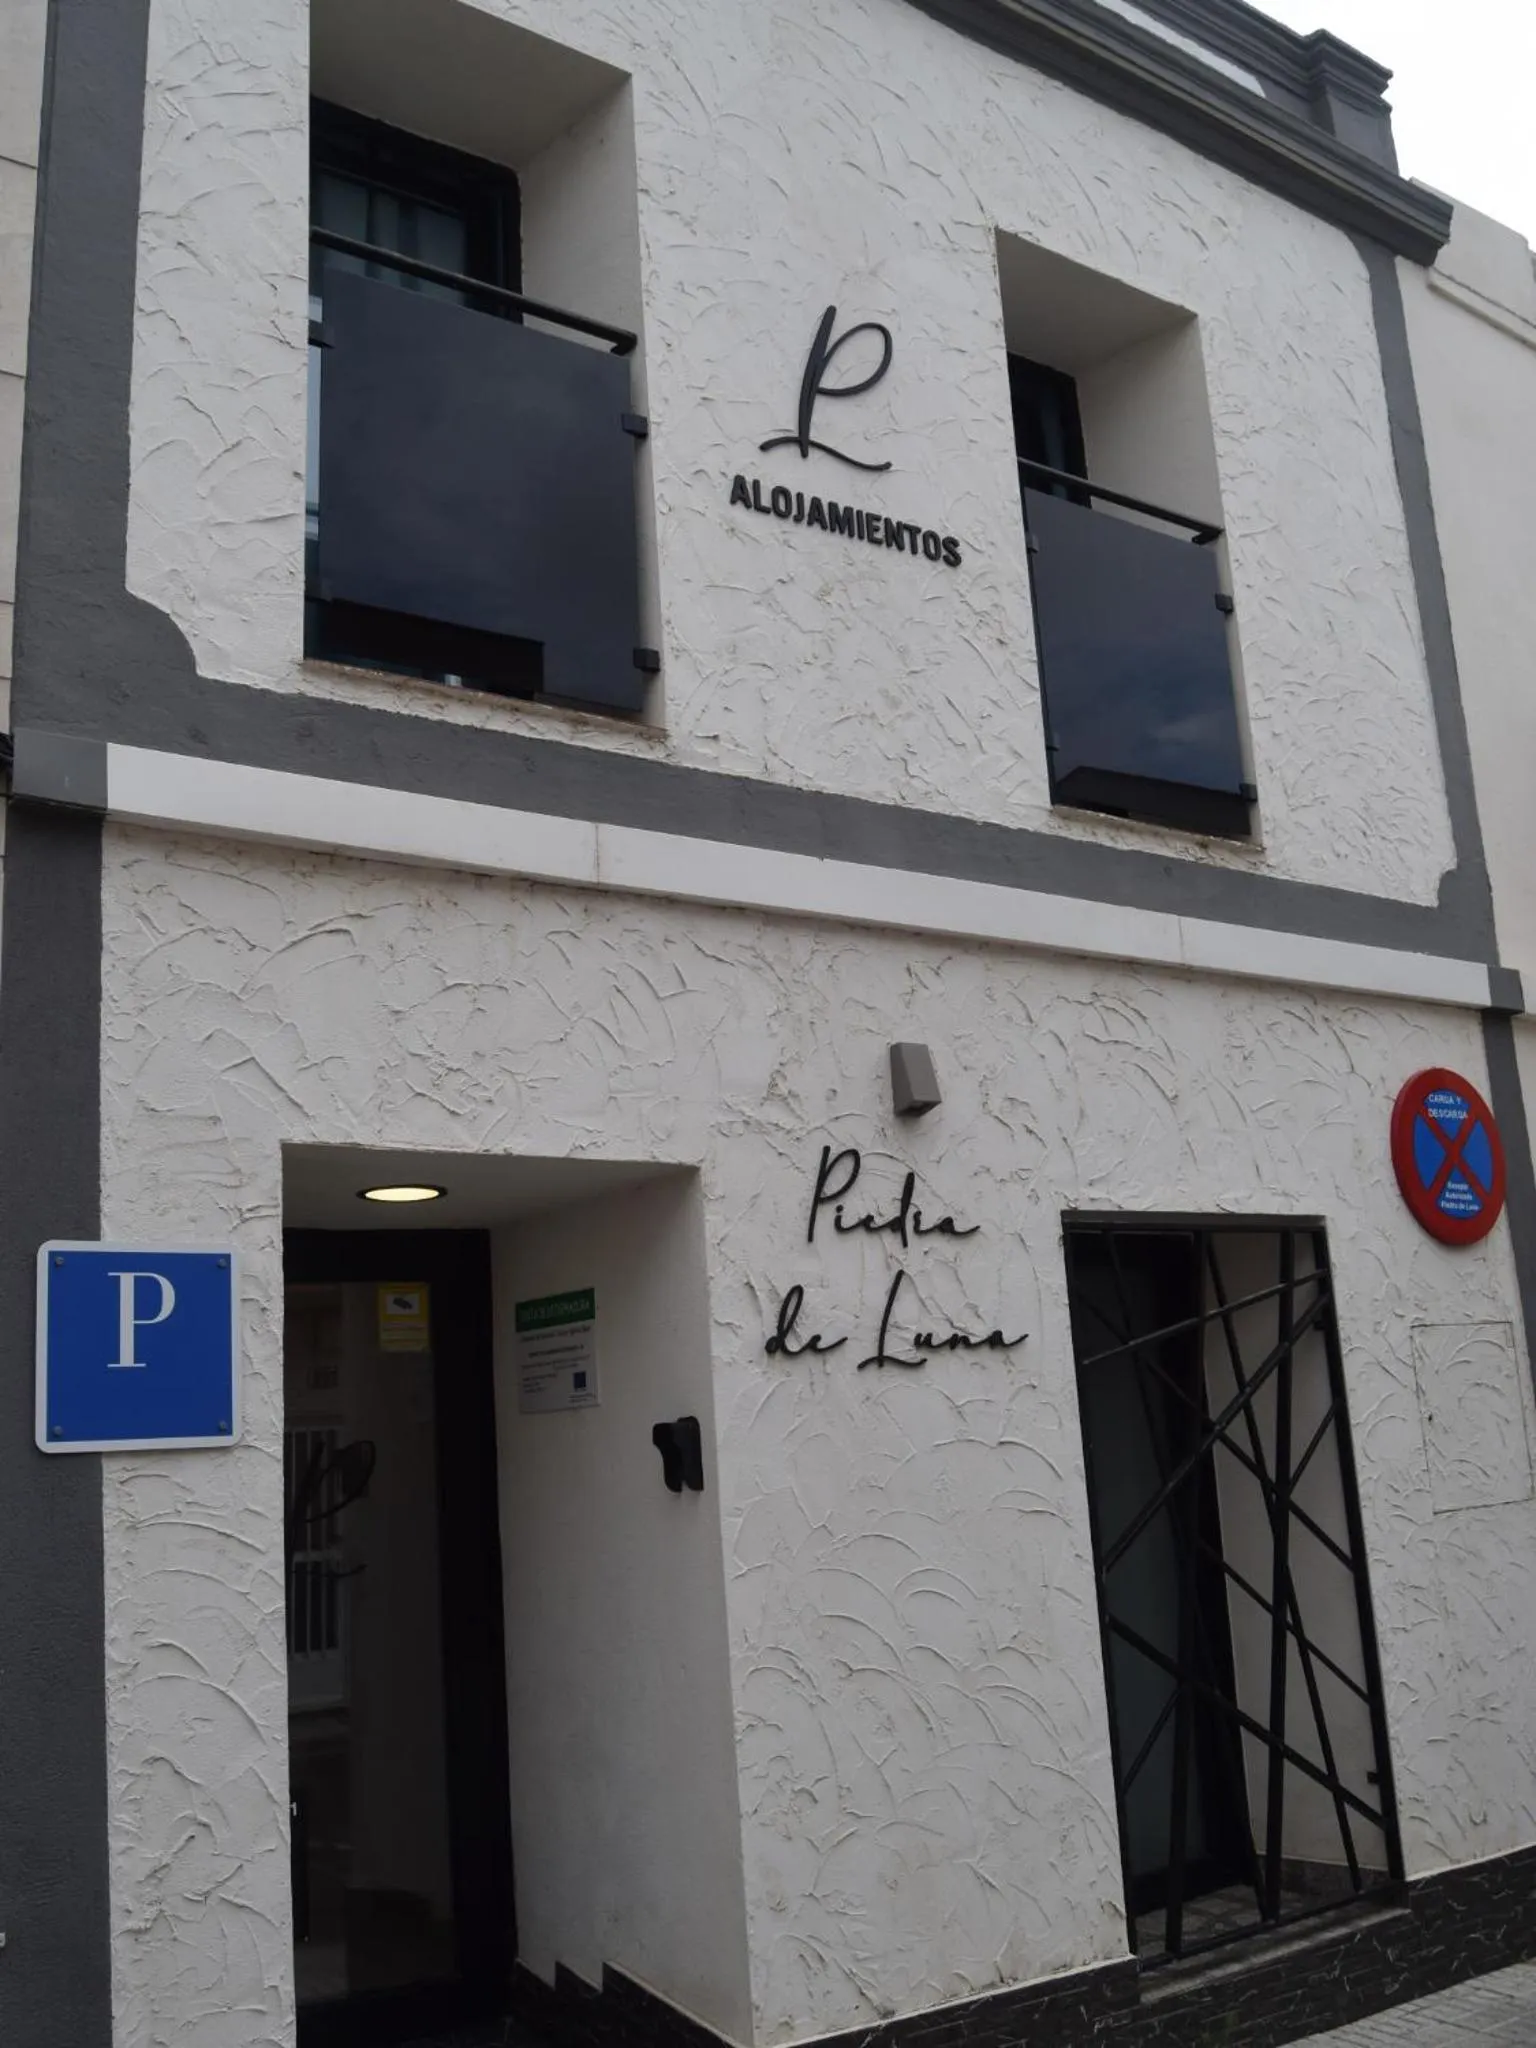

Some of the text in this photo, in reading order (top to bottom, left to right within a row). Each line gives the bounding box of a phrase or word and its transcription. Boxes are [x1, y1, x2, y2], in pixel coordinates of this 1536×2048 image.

[729, 474, 963, 568] ALOJAMIENTOS
[1428, 1094, 1463, 1105] CARGA Y
[1428, 1108, 1468, 1119] DESCARGA
[807, 1145, 981, 1249] Piedra
[106, 1271, 176, 1368] P
[765, 1268, 1029, 1370] de Luna
